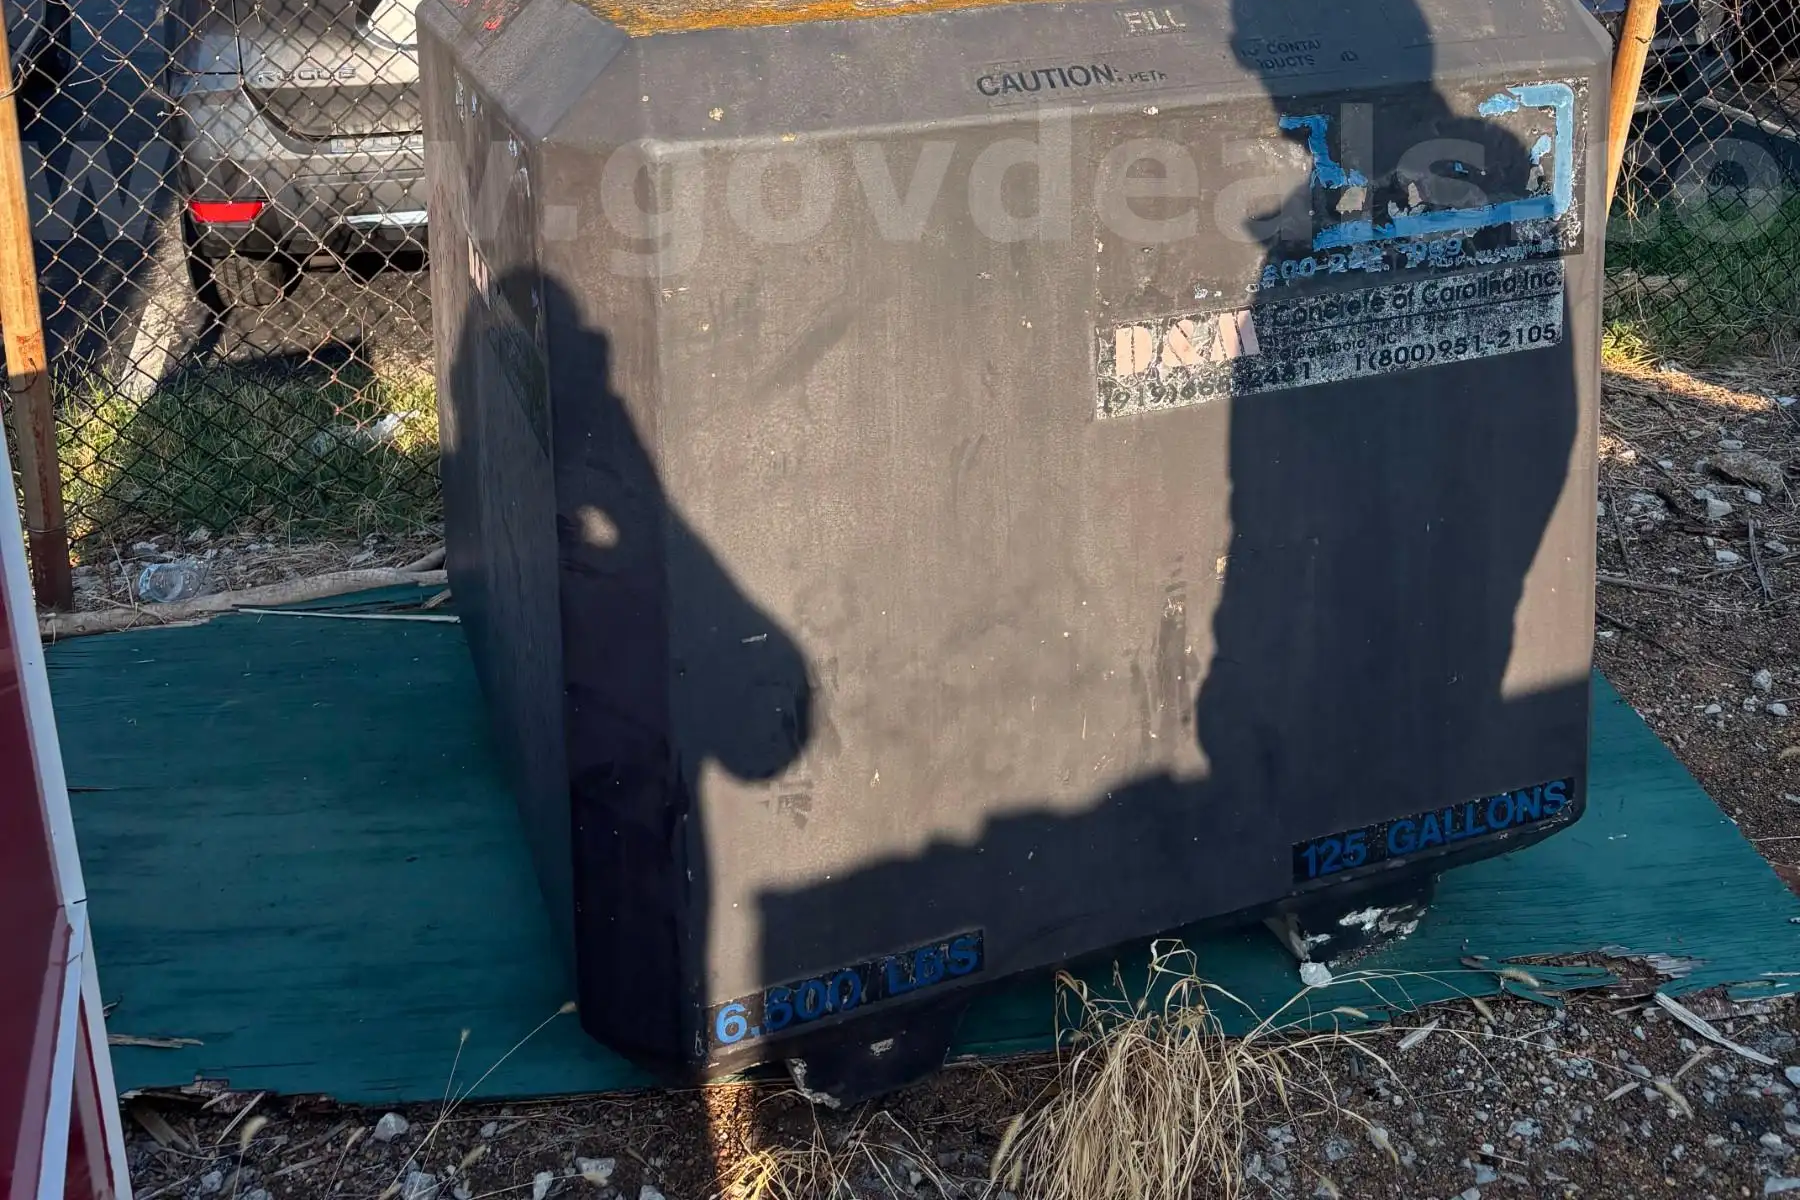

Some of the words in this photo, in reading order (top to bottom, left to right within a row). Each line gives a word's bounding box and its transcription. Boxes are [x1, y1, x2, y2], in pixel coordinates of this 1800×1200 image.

[1124, 8, 1186, 34] FILL
[1523, 267, 1562, 291] Inc.
[1302, 832, 1367, 878] 125
[1386, 780, 1567, 855] GALLONS
[887, 937, 978, 995] LBS
